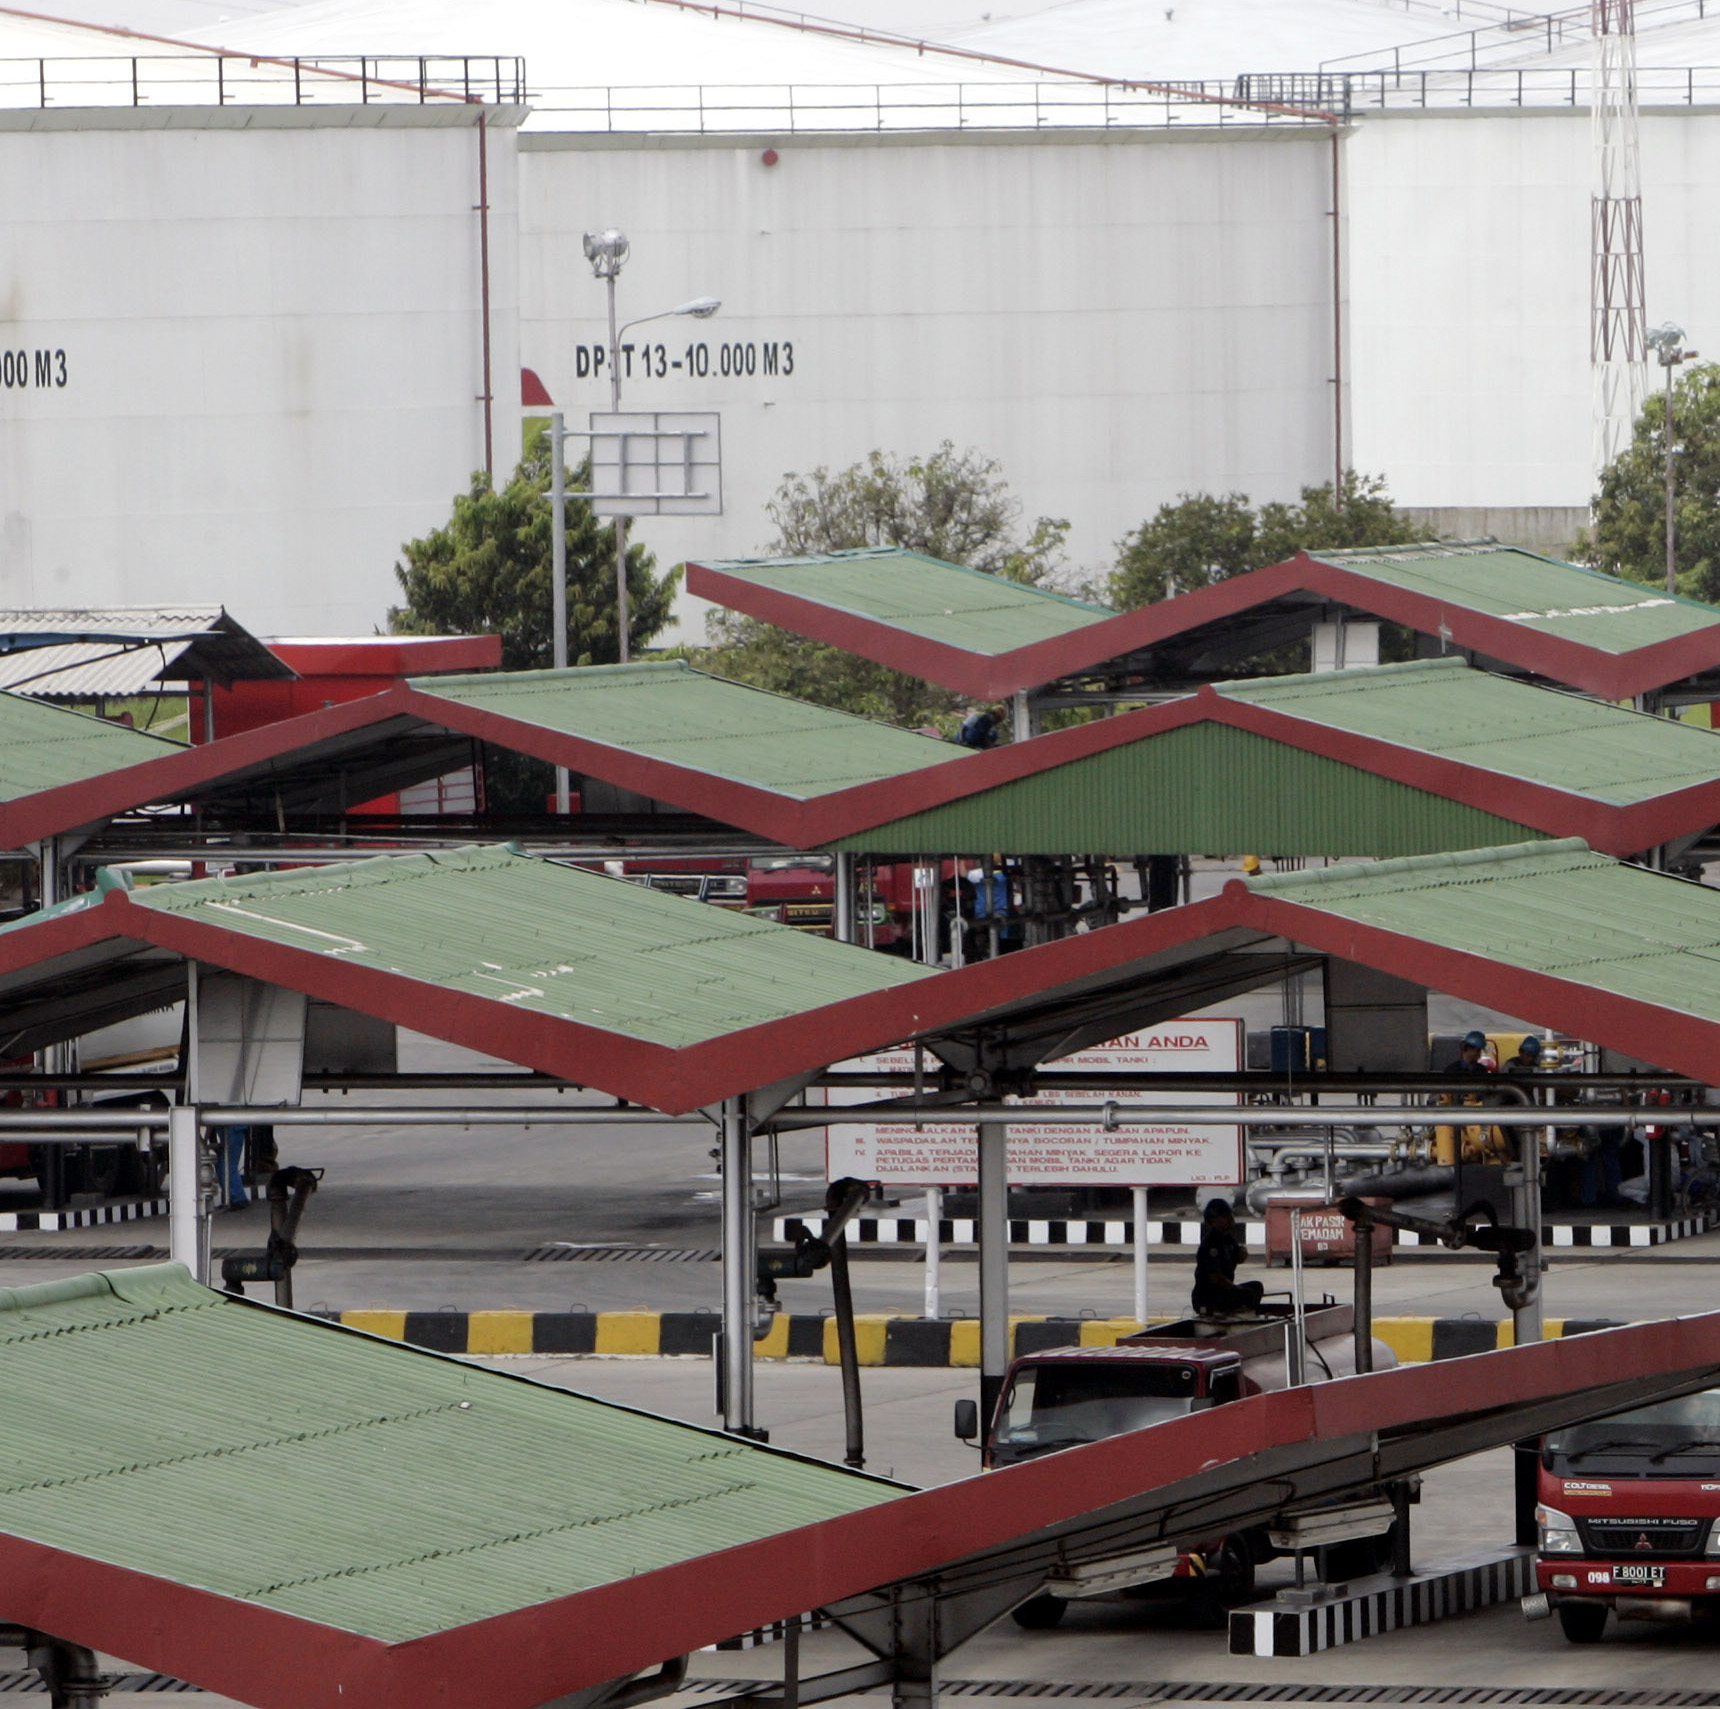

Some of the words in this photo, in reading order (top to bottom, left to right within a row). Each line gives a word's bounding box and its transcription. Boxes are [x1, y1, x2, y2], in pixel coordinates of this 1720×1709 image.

[0, 348, 28, 389] 00
[1148, 1035, 1209, 1048] ANDA
[1077, 1056, 1111, 1064] MOBIL
[1116, 1056, 1149, 1064] TANKI
[1315, 1215, 1345, 1228] PASIR
[1662, 1518, 1698, 1526] FUSO
[1612, 1566, 1620, 1577] F
[1651, 1566, 1665, 1578] ET
